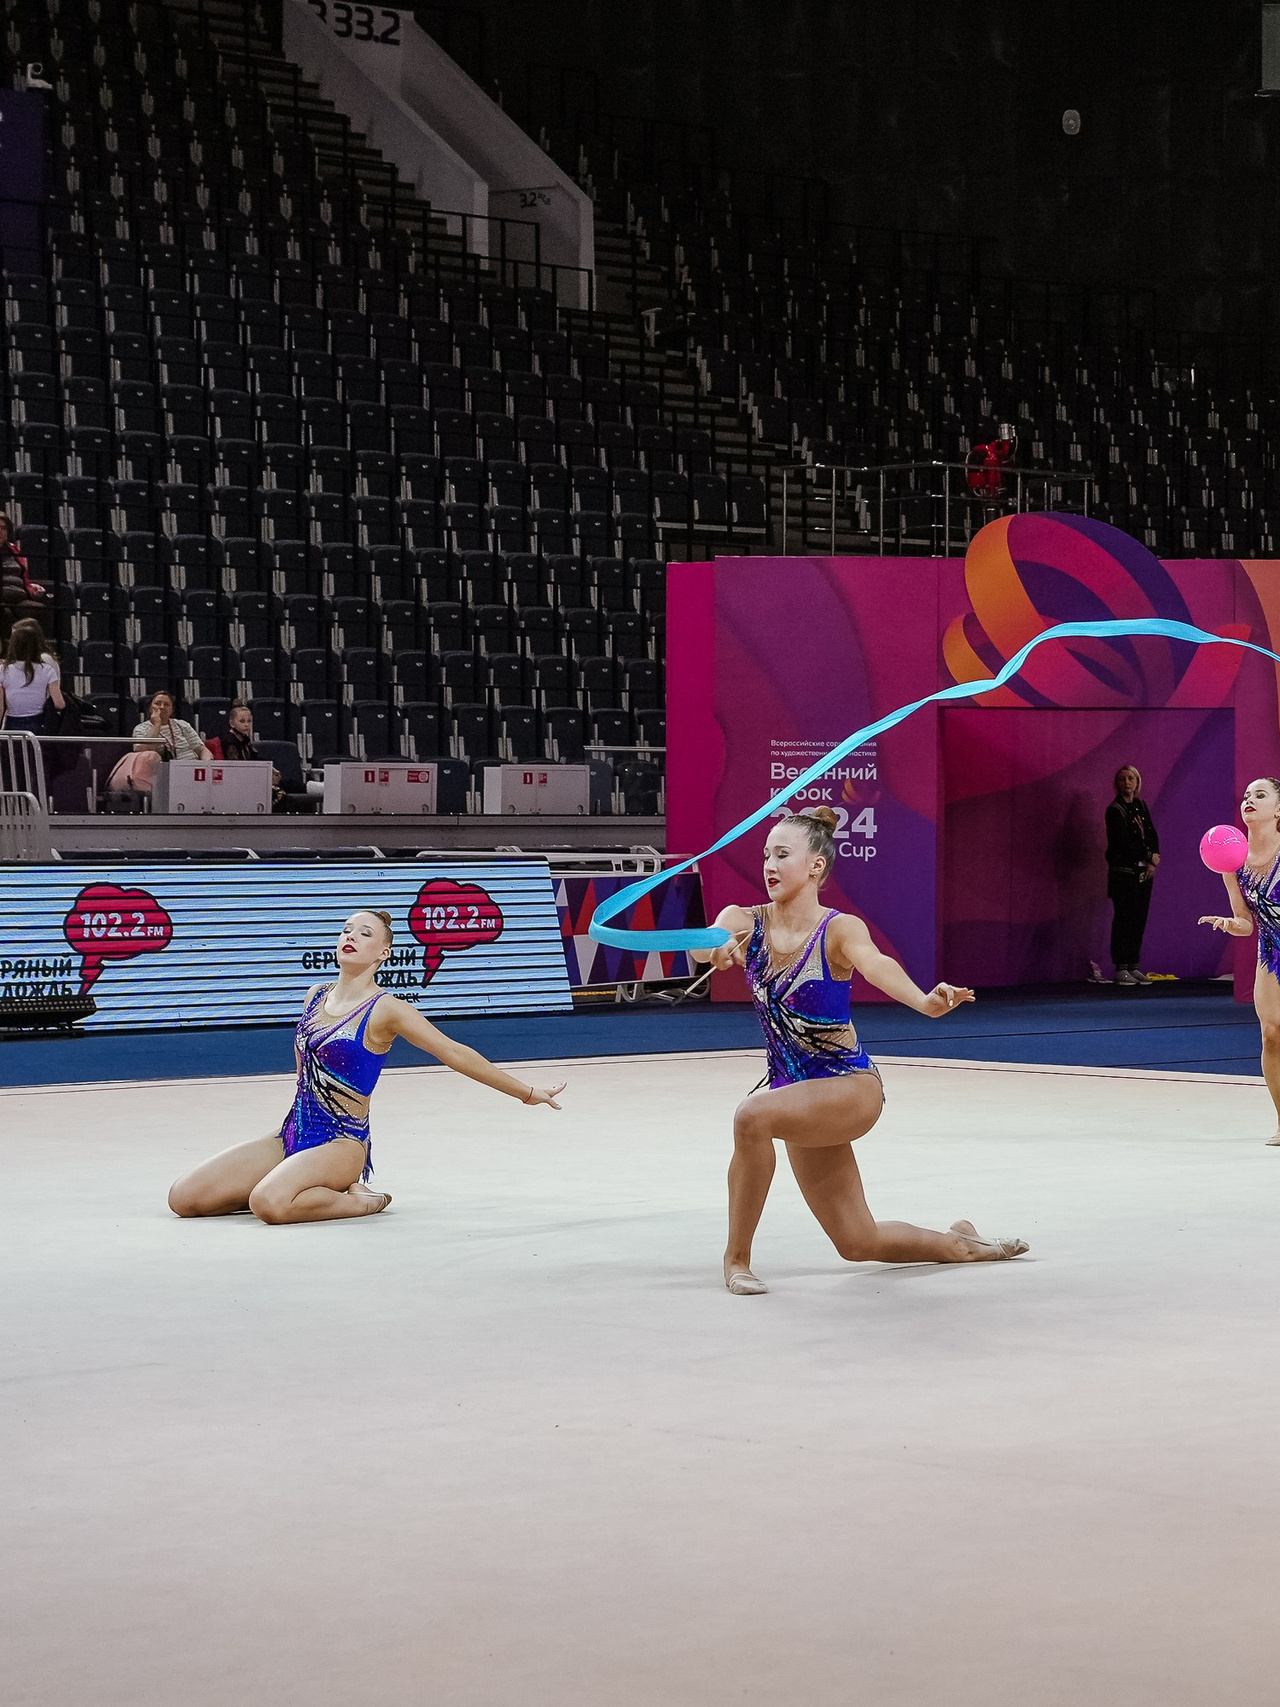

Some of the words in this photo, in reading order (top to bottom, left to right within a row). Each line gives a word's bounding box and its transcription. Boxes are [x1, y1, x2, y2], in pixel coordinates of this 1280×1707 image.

[770, 739, 825, 748] Всероссийские
[770, 762, 877, 780] Венний
[839, 841, 877, 862] Cup
[80, 912, 146, 938] 102.2
[147, 926, 164, 936] FM
[422, 906, 480, 930] 102.2
[480, 918, 496, 929] FM
